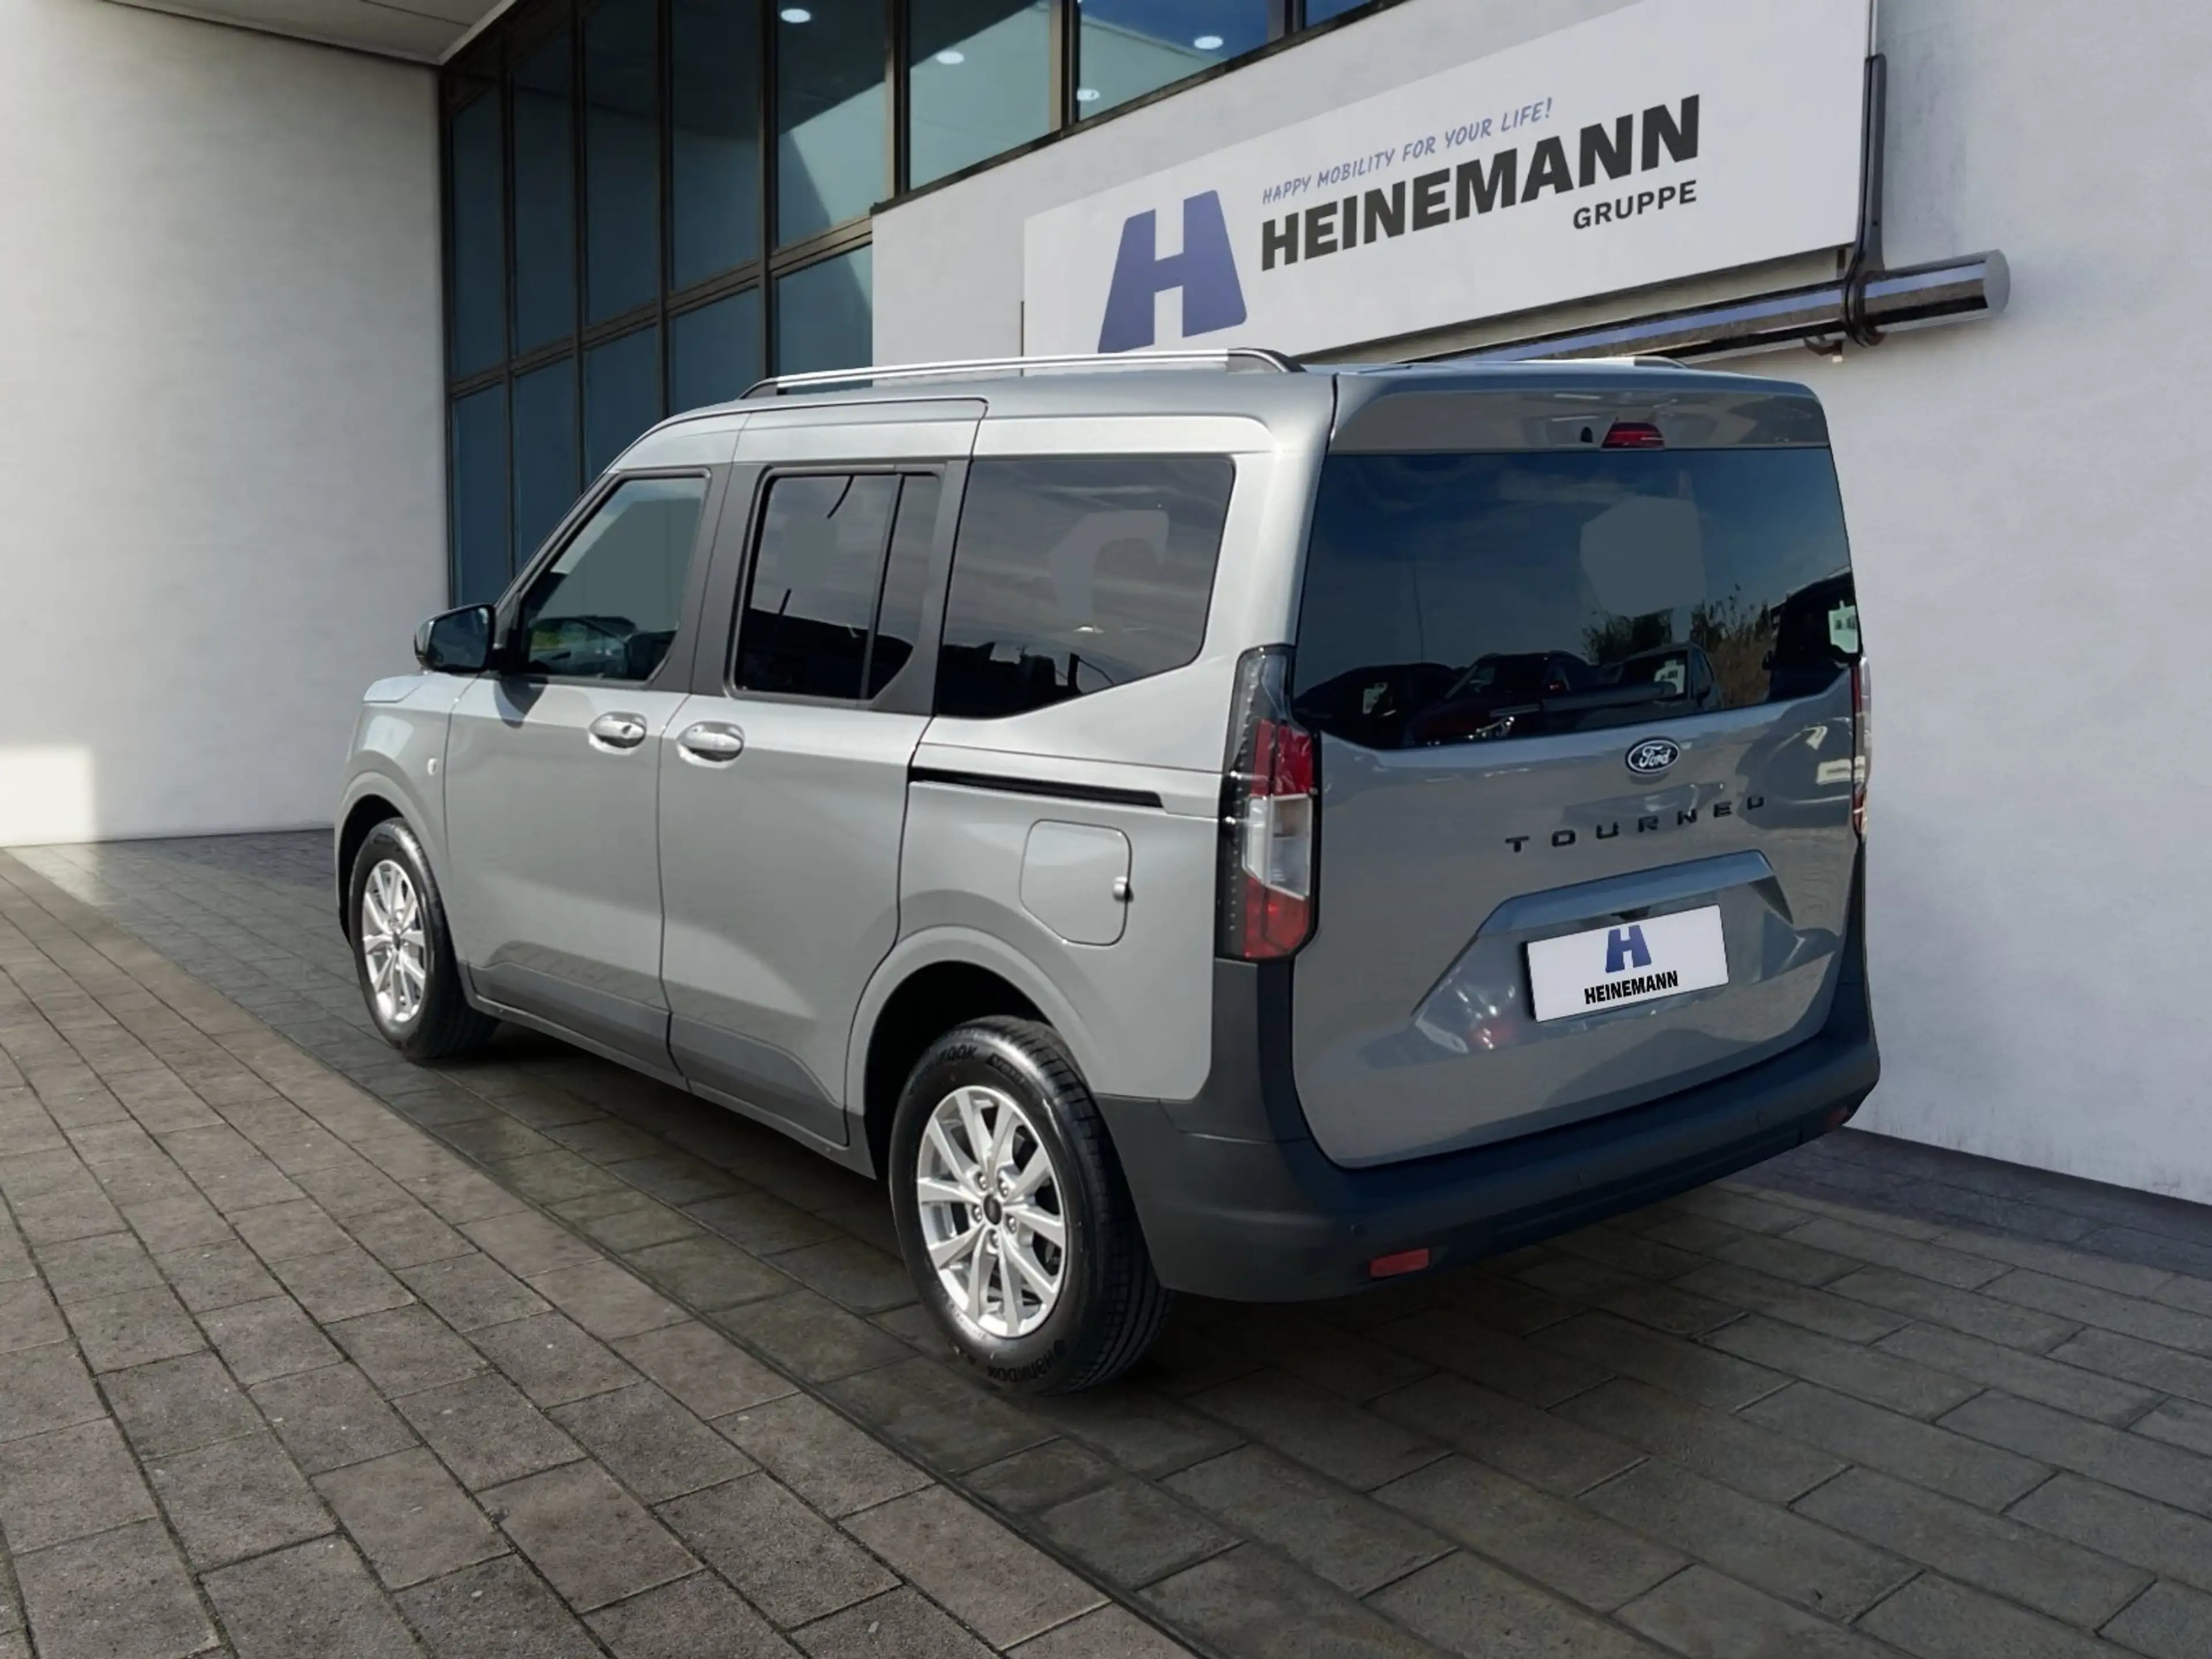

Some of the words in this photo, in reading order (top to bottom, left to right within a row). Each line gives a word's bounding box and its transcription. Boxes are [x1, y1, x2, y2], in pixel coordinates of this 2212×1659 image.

[1262, 176, 1311, 204] HAPPY
[1317, 149, 1395, 188] MOBILITY
[1402, 135, 1435, 161] FOR
[1445, 118, 1493, 148] YOUR
[1501, 97, 1552, 131] LIFE!
[1262, 94, 1699, 271] HEINEMANN
[1573, 179, 1696, 230] GRUPPE
[1098, 190, 1247, 353] H
[1639, 745, 1671, 768] Ford
[1605, 925, 1652, 973] H
[1584, 970, 1679, 1005] HEINEMANN
